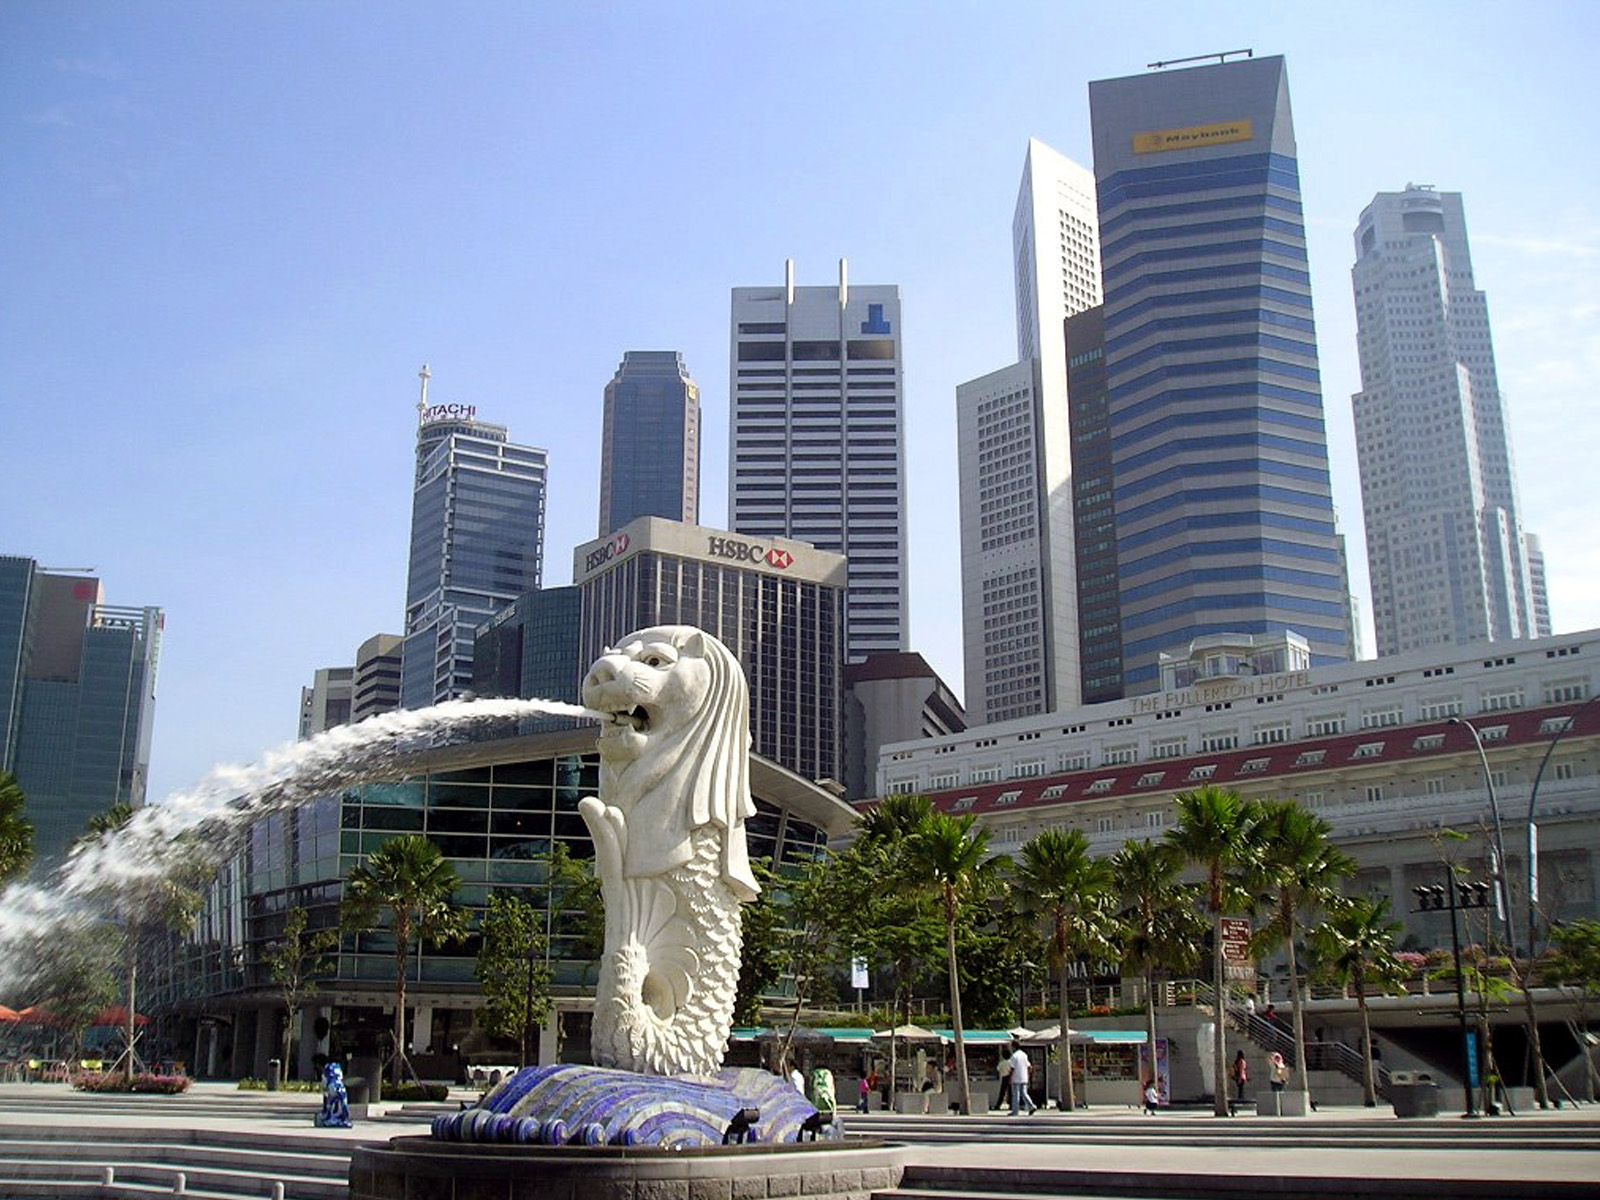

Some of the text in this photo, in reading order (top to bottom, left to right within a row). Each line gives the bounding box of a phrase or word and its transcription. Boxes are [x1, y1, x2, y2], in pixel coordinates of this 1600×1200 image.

[1166, 127, 1240, 143] Maybank
[585, 541, 614, 573] HSBC
[708, 536, 764, 564] HSBC
[1132, 673, 1311, 713] THE FULLERTON HOTEL
